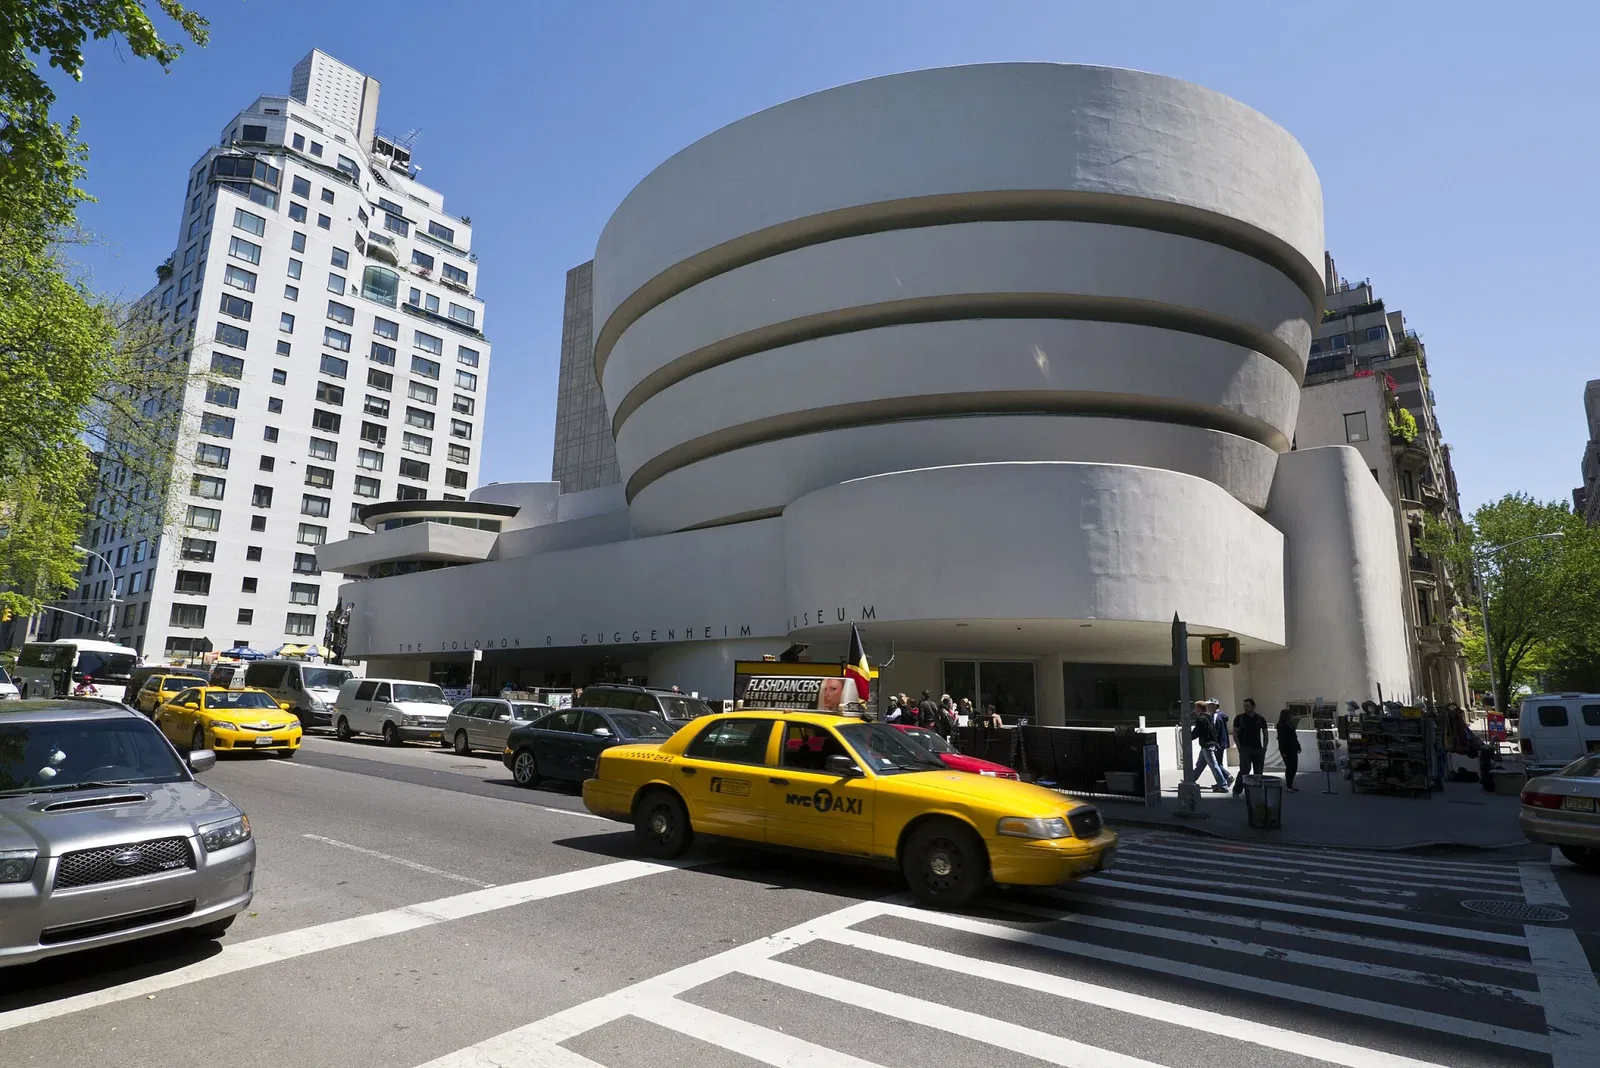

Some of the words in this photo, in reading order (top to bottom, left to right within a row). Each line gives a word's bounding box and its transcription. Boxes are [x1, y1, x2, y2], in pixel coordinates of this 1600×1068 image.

[399, 642, 422, 652] THE
[442, 638, 520, 650] SOLOMON
[546, 635, 552, 646] R
[581, 625, 751, 644] GUGGENHEIM
[747, 679, 821, 693] FLASHDANCERS
[745, 691, 795, 701] GENTLEMEN'S
[798, 693, 817, 702] CLUB
[750, 700, 766, 708] 52ND
[775, 701, 809, 709] BROADWAY
[786, 792, 812, 808] NYC
